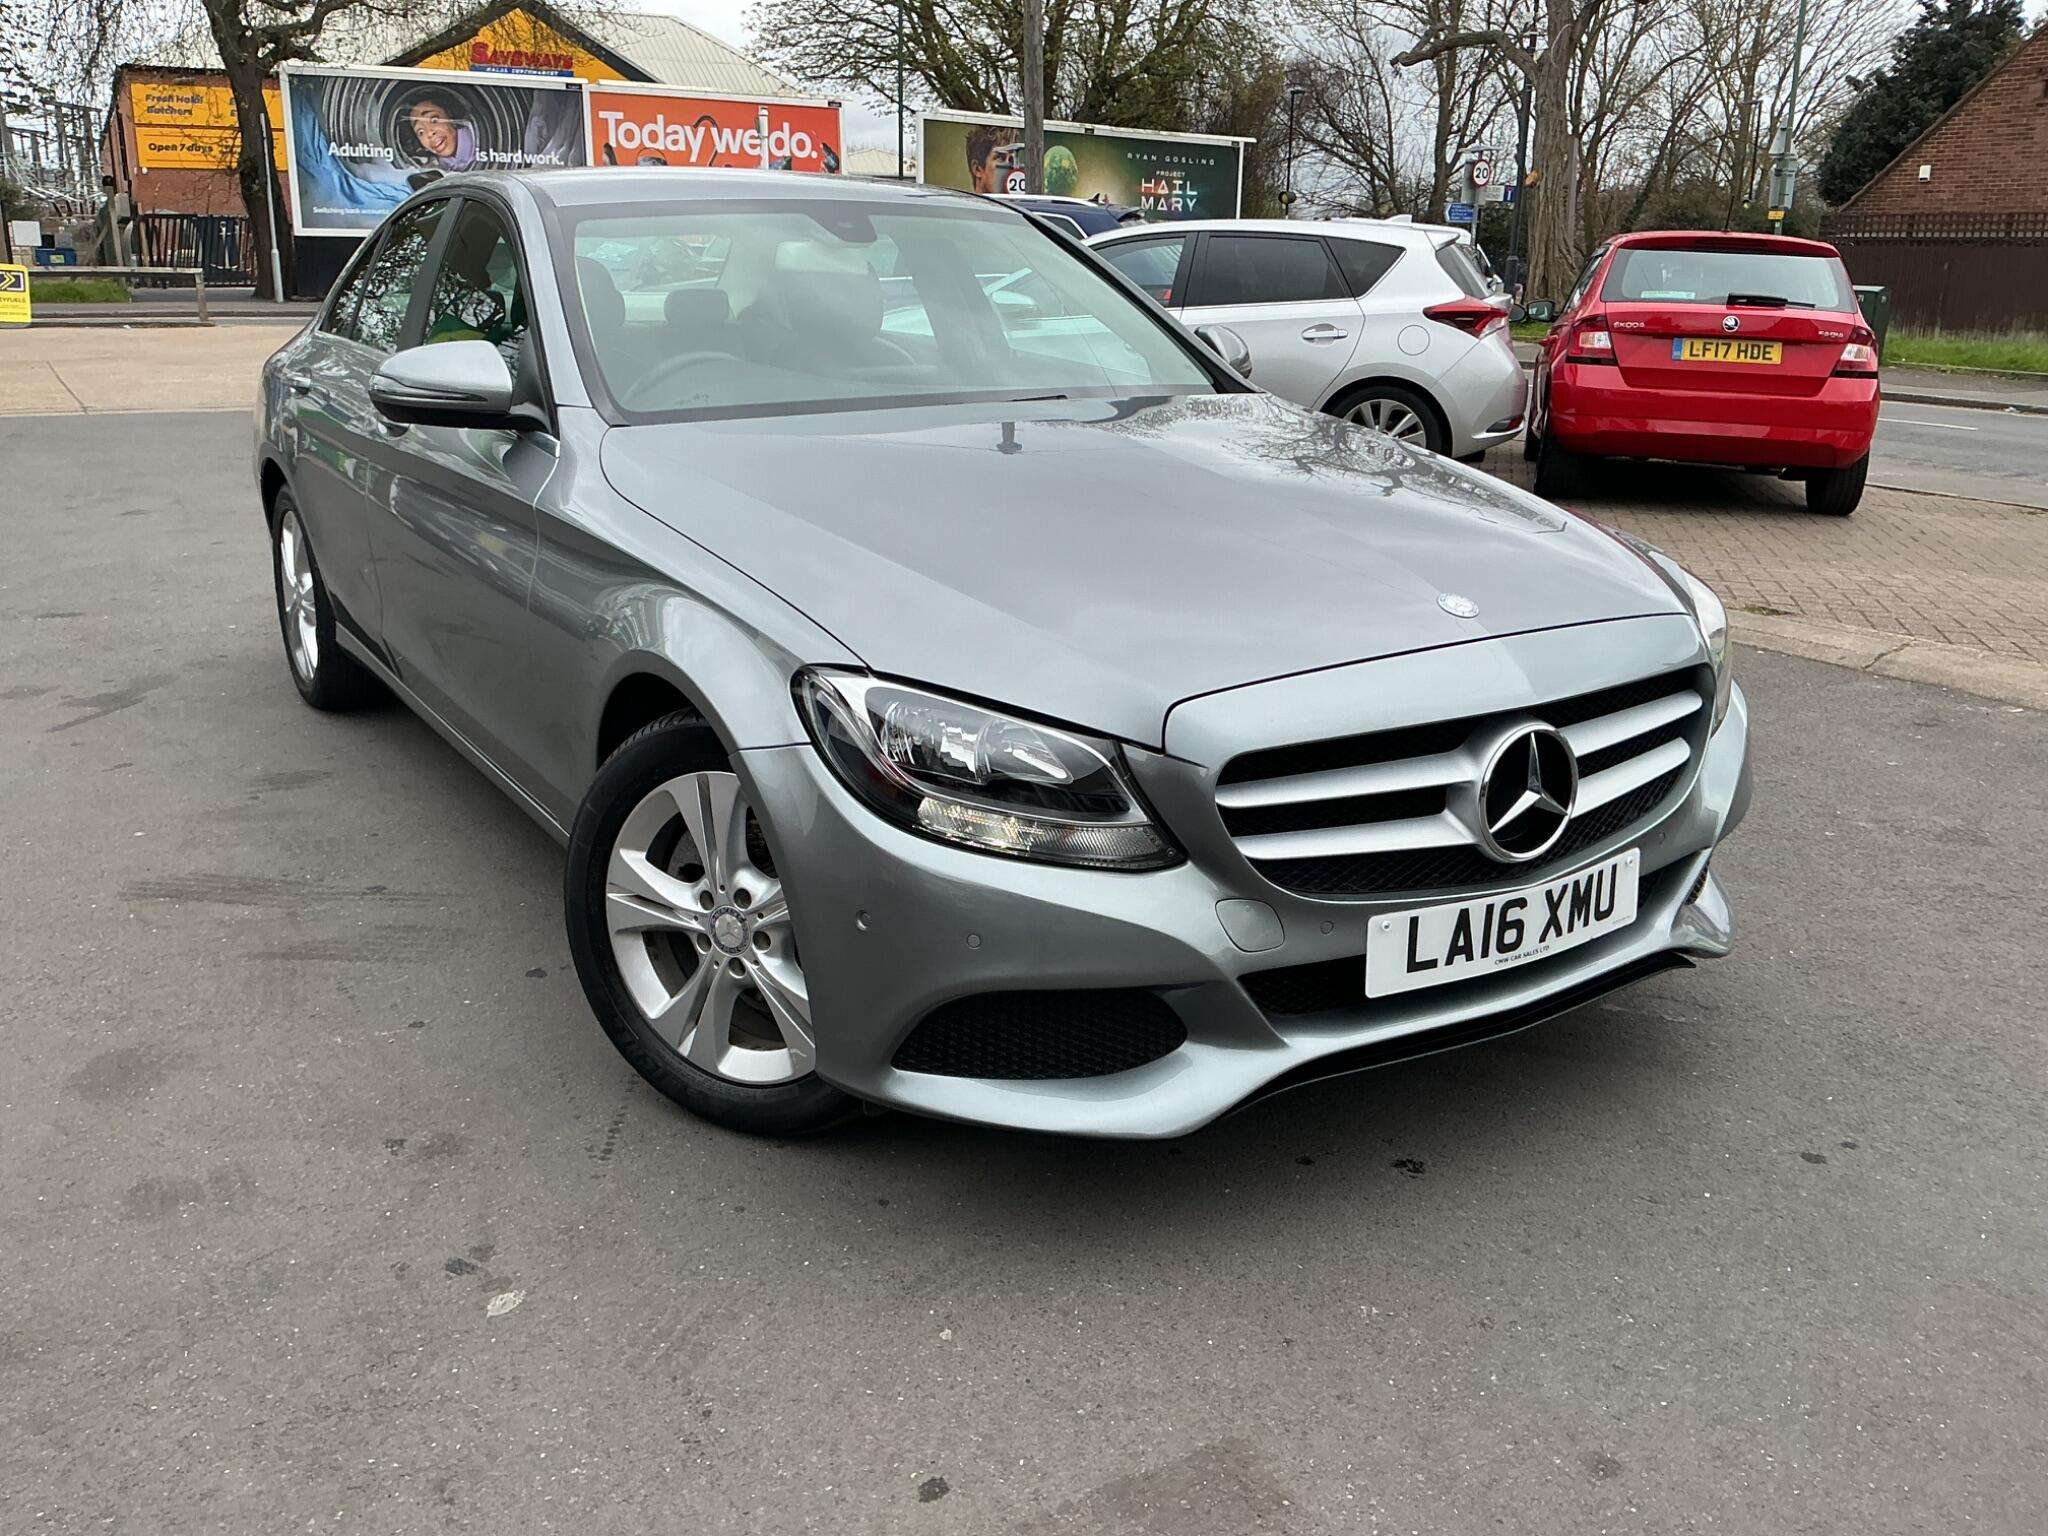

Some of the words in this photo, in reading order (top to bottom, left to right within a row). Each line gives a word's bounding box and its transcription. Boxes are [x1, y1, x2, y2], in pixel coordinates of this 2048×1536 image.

[598, 111, 706, 163] Today
[710, 127, 762, 156] we
[768, 122, 818, 159] do.
[148, 142, 178, 152] Open
[179, 142, 185, 151] 7
[187, 142, 213, 154] days
[328, 141, 394, 162] Adulting
[476, 148, 488, 162] is
[490, 149, 522, 164] hard
[524, 151, 564, 165] work.
[1127, 152, 1157, 161] RYAN
[1165, 155, 1215, 166] GOSLING
[1156, 170, 1186, 178] PROJECT
[1475, 167, 1489, 179] 20
[1009, 178, 1026, 191] 20
[1141, 178, 1198, 195] HAIL
[1141, 196, 1197, 212] MARY
[1689, 342, 1730, 360] LF17
[1736, 342, 1773, 361] HDE
[1406, 897, 1528, 974] LA16
[1538, 863, 1618, 944] XMU
